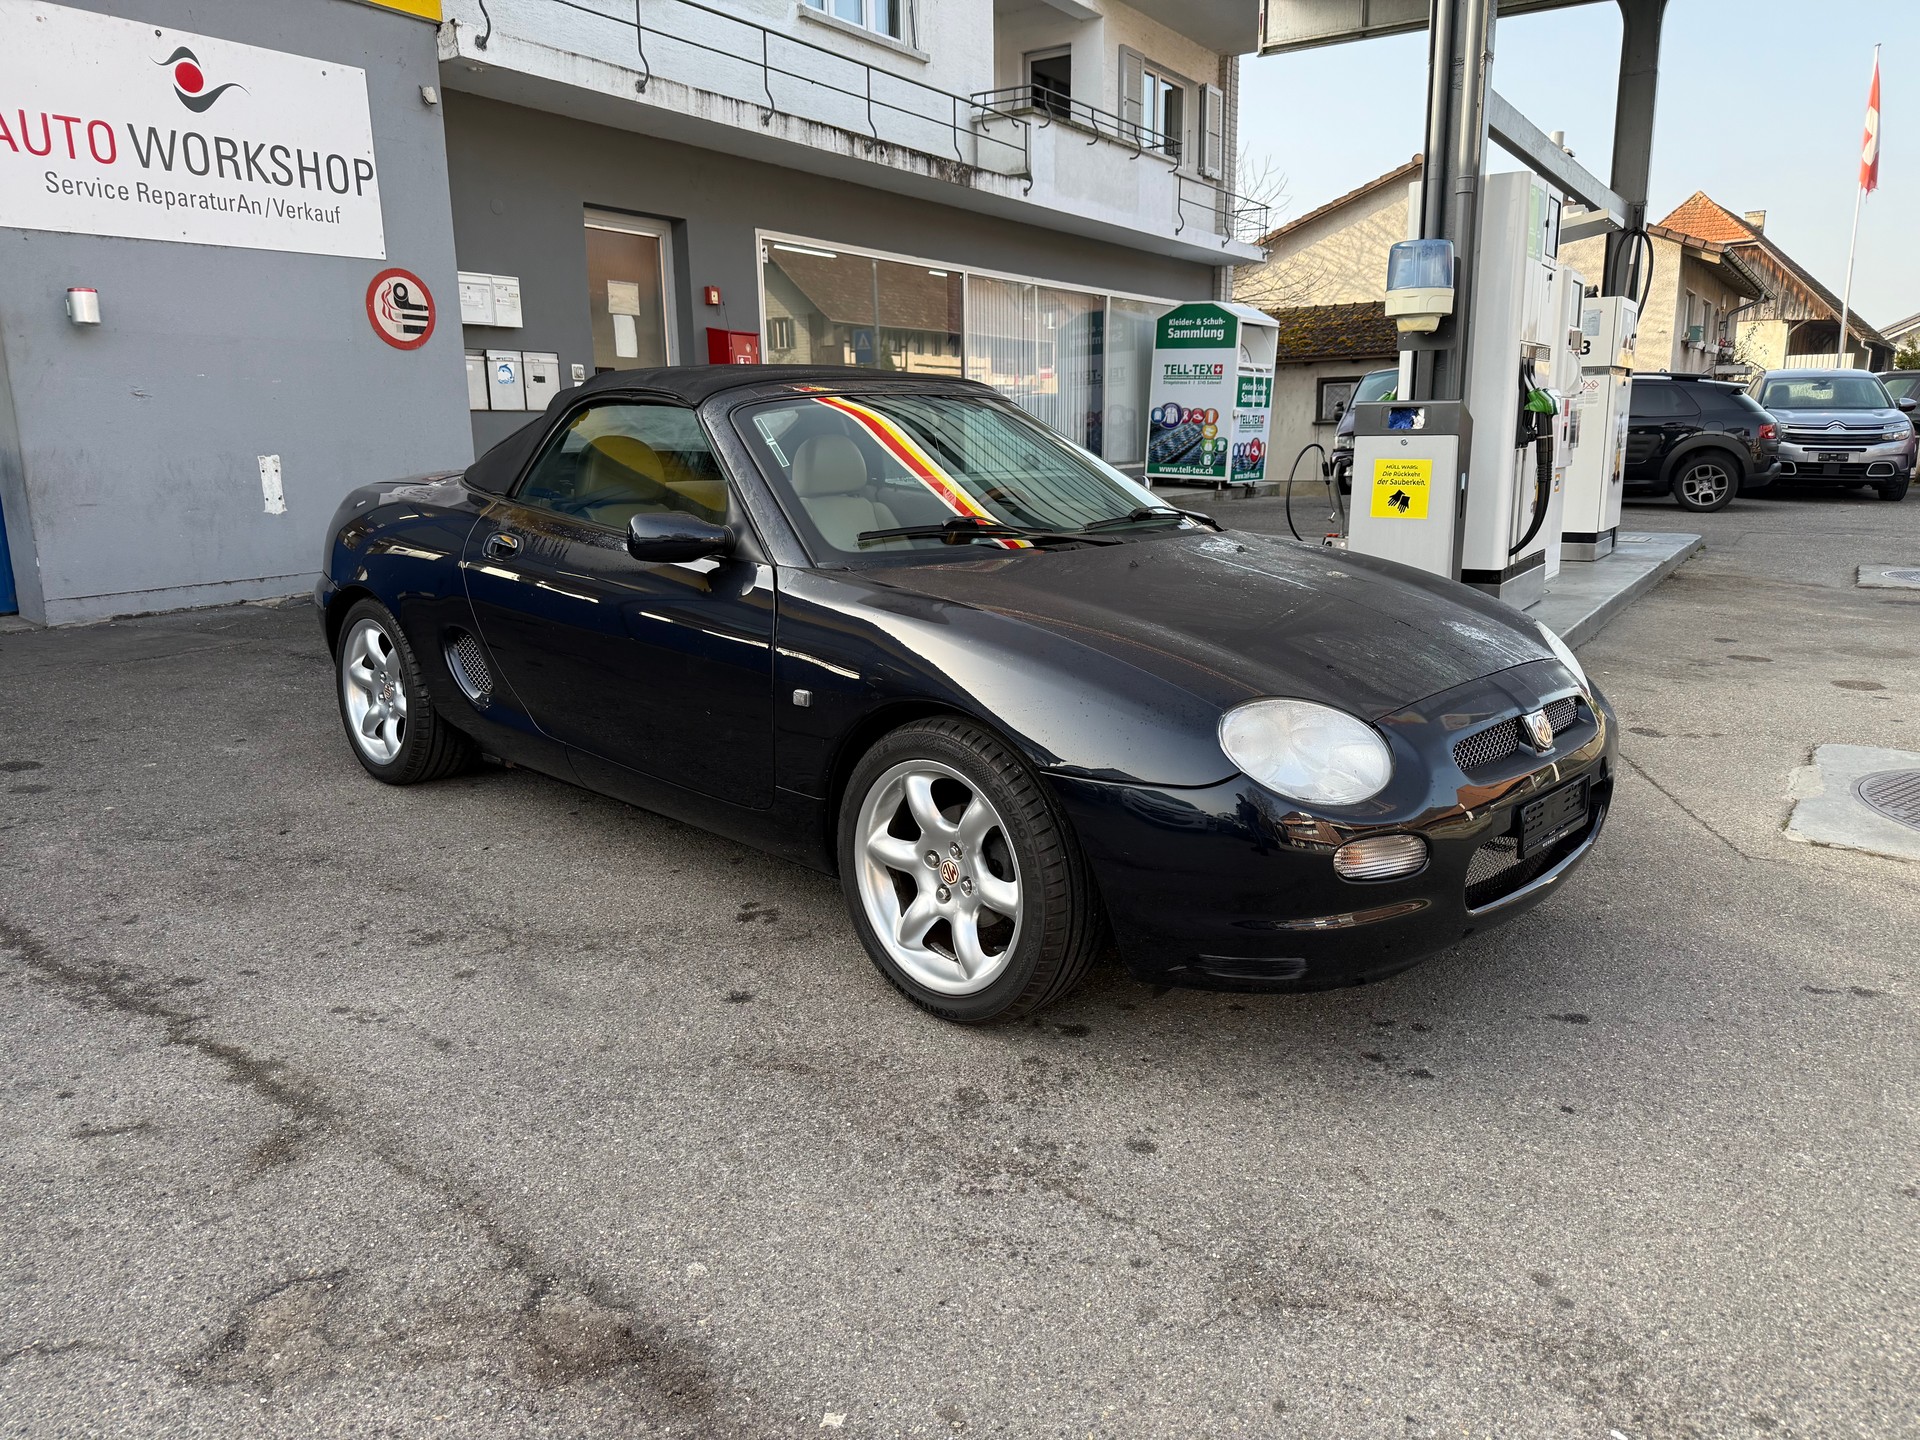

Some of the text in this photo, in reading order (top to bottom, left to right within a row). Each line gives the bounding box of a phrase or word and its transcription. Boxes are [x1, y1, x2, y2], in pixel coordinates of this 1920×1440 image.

[126, 122, 374, 197] WORKSHOP
[45, 170, 130, 201] Service
[1168, 317, 1226, 326] Kleider- & Schuh-
[1167, 326, 1225, 341] Sammlung
[1580, 340, 1591, 356] 3
[1163, 364, 1213, 375] TELL-TEX
[1158, 466, 1213, 475] www.tell-tex.ch
